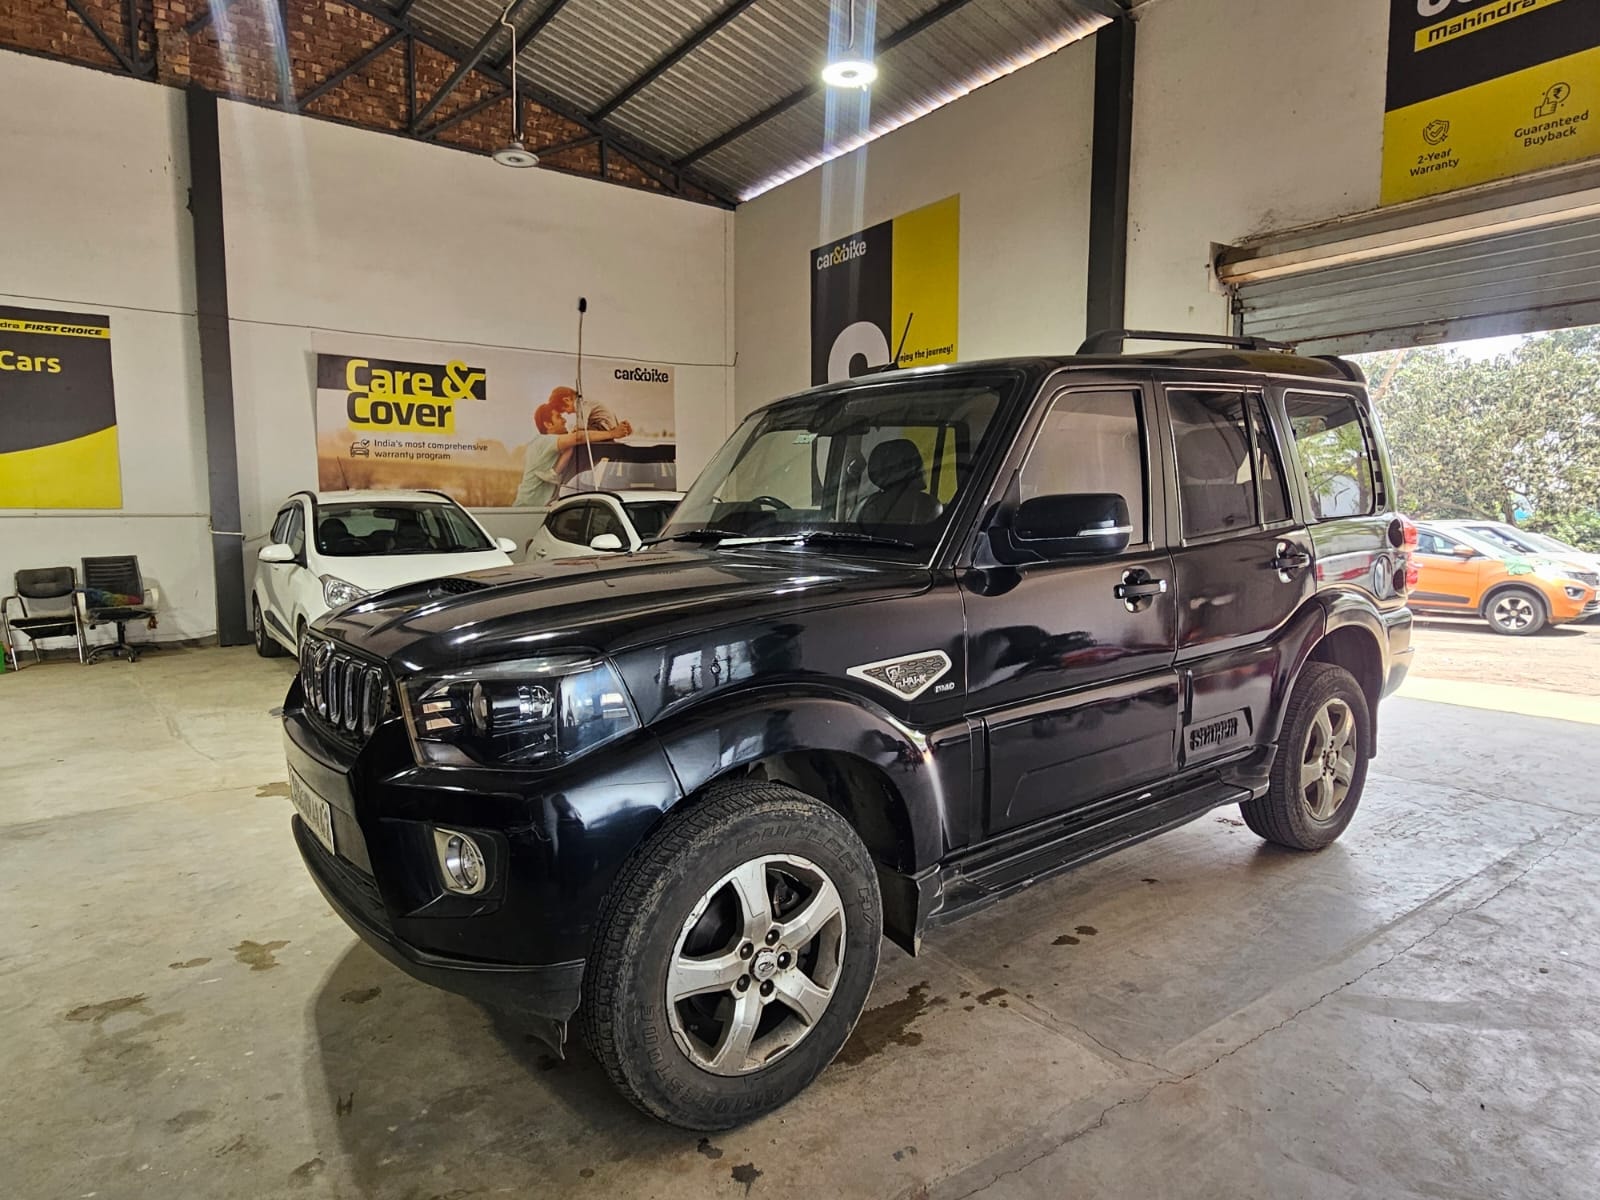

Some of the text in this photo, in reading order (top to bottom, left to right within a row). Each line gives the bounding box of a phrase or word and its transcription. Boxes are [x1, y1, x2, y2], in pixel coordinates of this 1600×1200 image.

[1427, 0, 1536, 43] Mahindra
[1513, 110, 1589, 138] Guaranteed
[1523, 126, 1577, 148] Buyback
[1417, 148, 1453, 165] 2-Year
[1409, 158, 1460, 177] Warranty
[816, 240, 867, 270] car&bike
[24, 323, 60, 333] FIRST
[60, 326, 103, 336] CHOICE
[0, 350, 62, 374] Cars
[898, 343, 954, 363] njoy the journey!
[346, 359, 486, 400] Care &
[614, 367, 670, 383] car&bike
[347, 391, 452, 428] Cover
[374, 439, 489, 452] India's most comprehensive
[374, 450, 452, 461] warranty program
